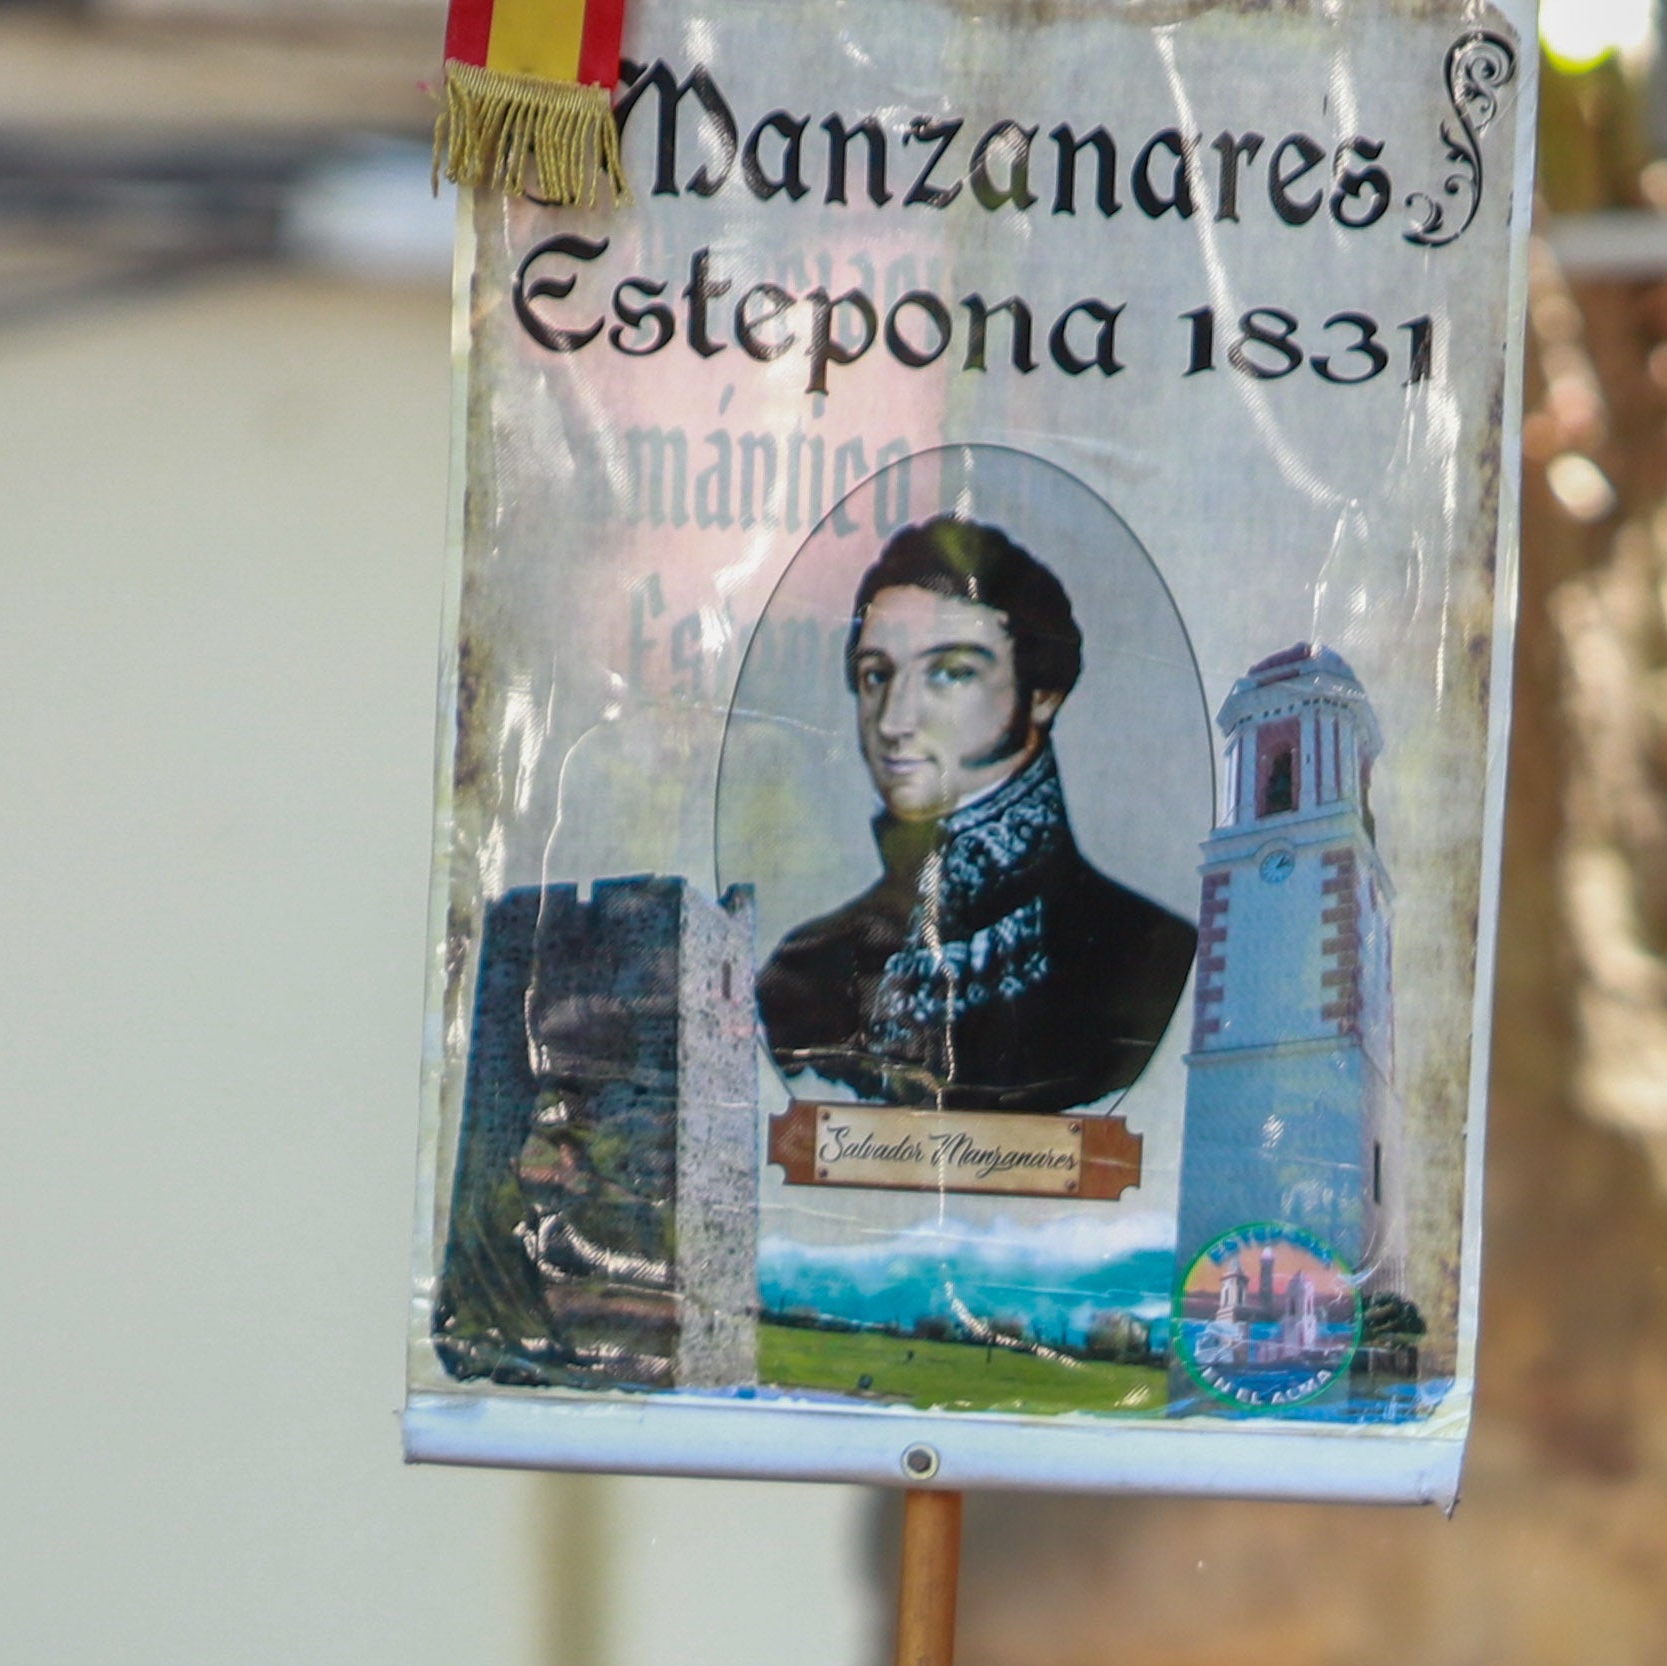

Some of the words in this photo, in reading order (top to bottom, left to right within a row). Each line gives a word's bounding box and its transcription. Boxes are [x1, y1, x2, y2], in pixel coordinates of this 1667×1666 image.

[524, 57, 1392, 228] Manzanares
[512, 232, 1127, 397] Estepona
[1178, 304, 1434, 388] 1831
[818, 1125, 926, 1164] Salvador
[928, 1132, 1079, 1179] Manzanares
[1234, 1386, 1263, 1406] EL
[1270, 1368, 1333, 1406] ALMA
